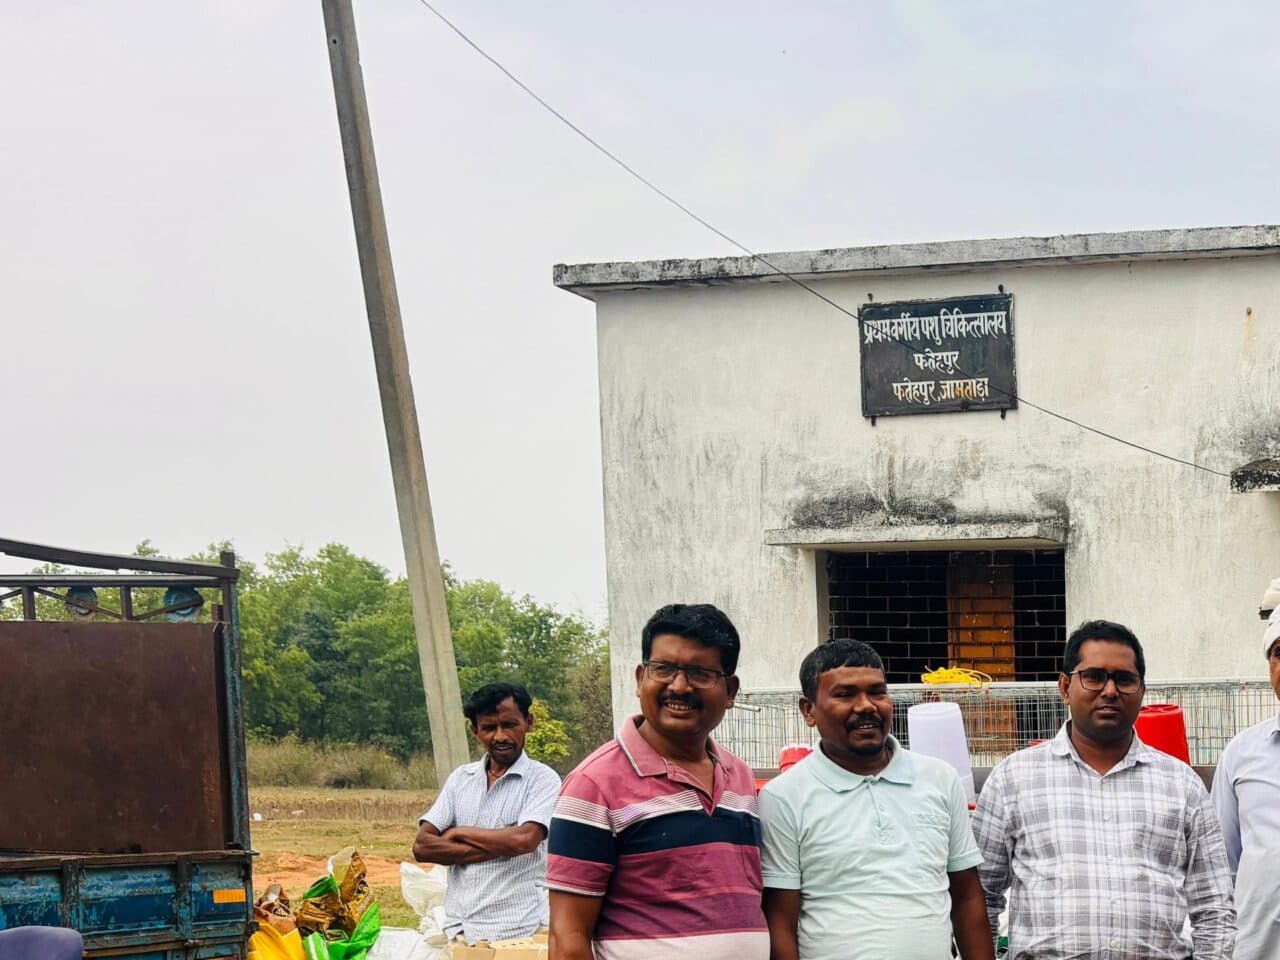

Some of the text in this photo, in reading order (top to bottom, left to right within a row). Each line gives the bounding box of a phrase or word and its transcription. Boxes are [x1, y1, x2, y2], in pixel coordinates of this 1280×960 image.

[921, 316, 942, 345] पशु
[940, 308, 1007, 339] चिकित्सालय
[913, 348, 961, 375] फतेहपुर
